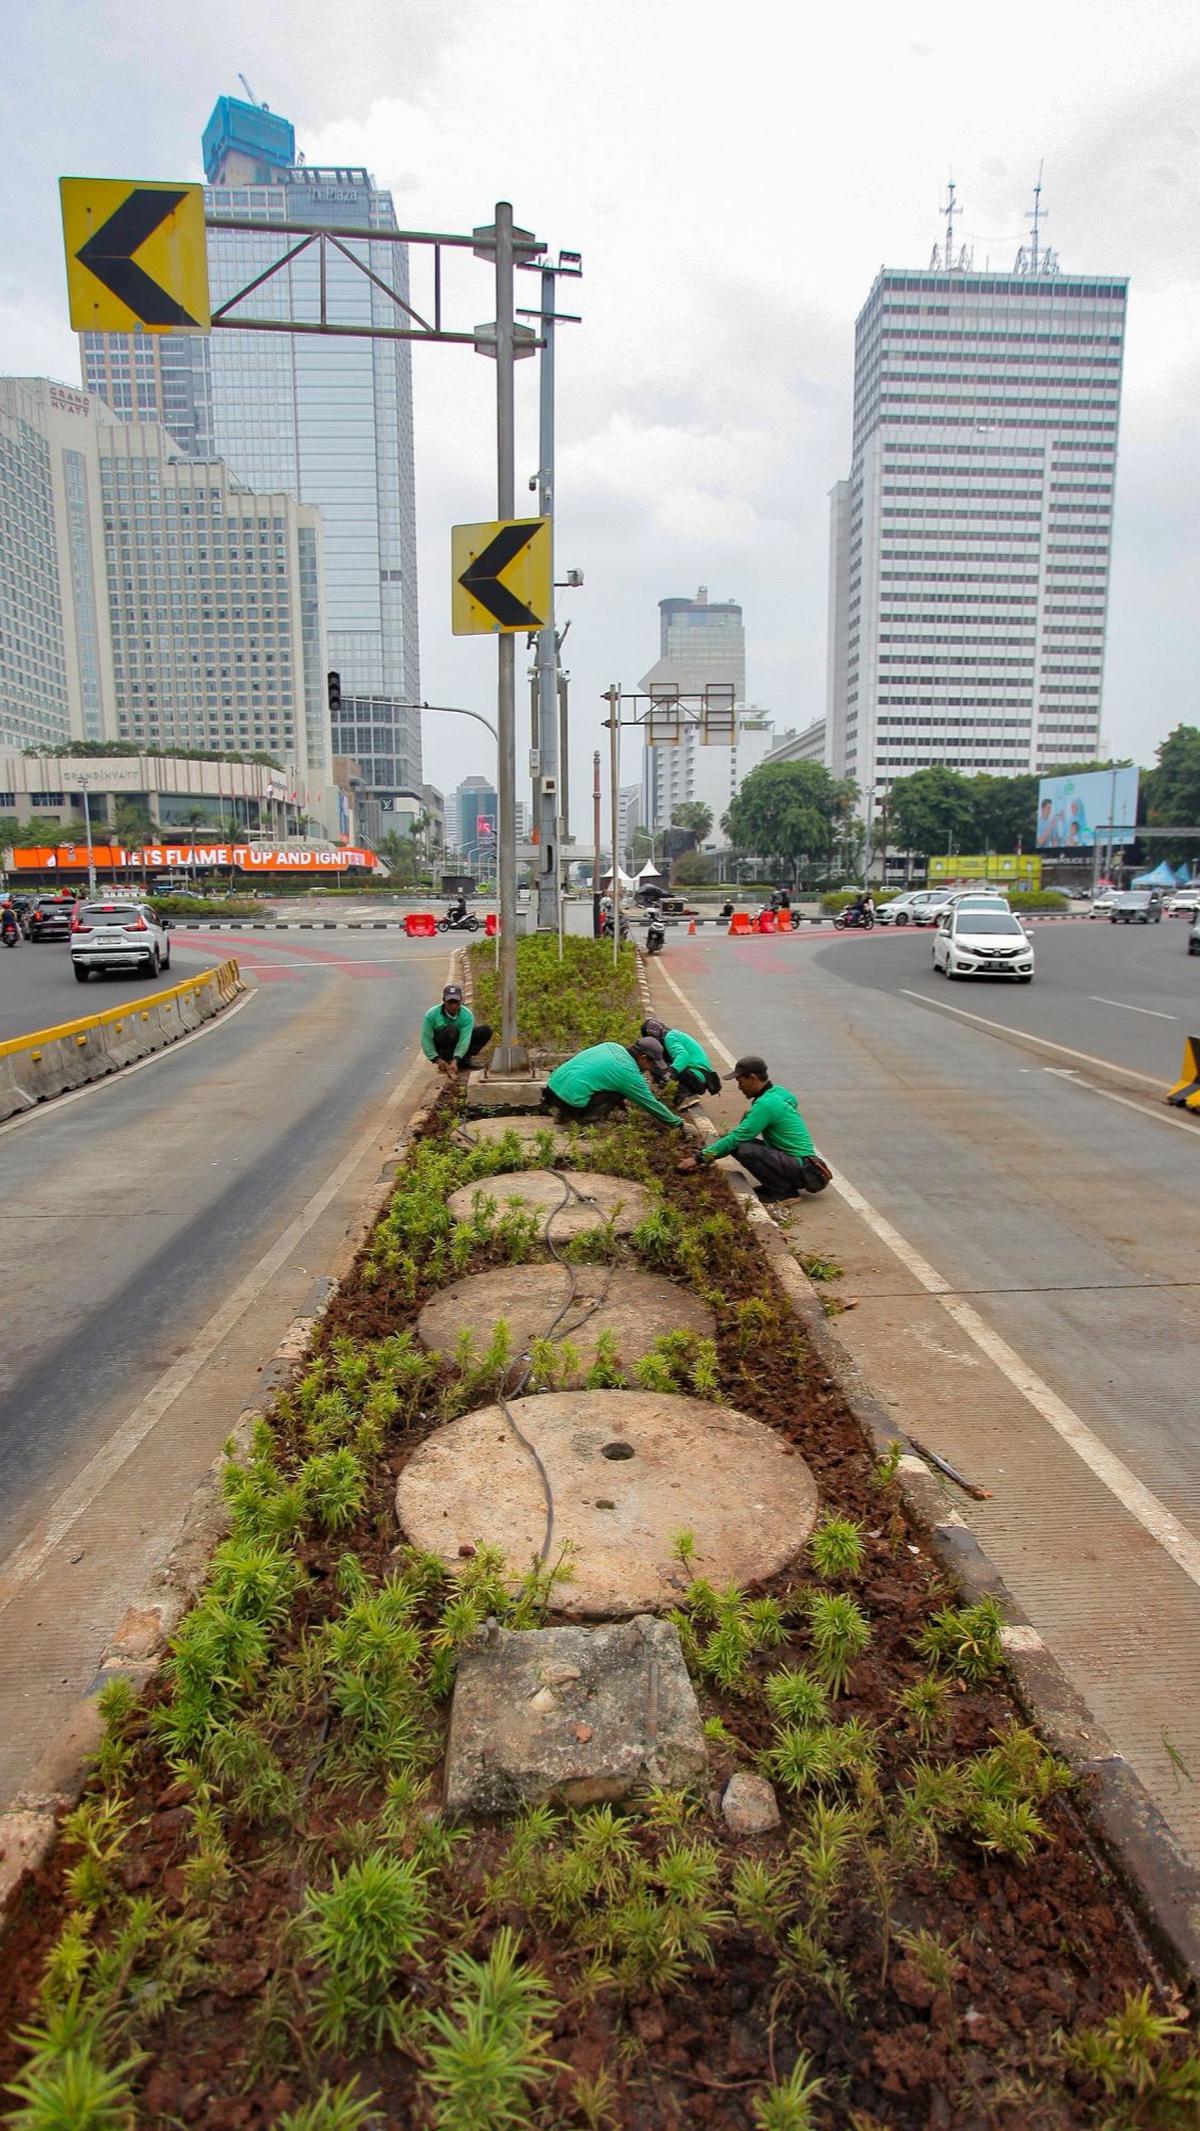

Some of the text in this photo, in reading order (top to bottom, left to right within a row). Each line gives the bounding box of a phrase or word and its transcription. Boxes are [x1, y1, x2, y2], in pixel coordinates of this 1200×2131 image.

[49, 387, 90, 406] GRAND
[50, 400, 90, 418] HYATT
[166, 850, 228, 865] FLAME
[233, 849, 247, 865] IT
[250, 850, 272, 865] UP
[276, 851, 311, 865] AND
